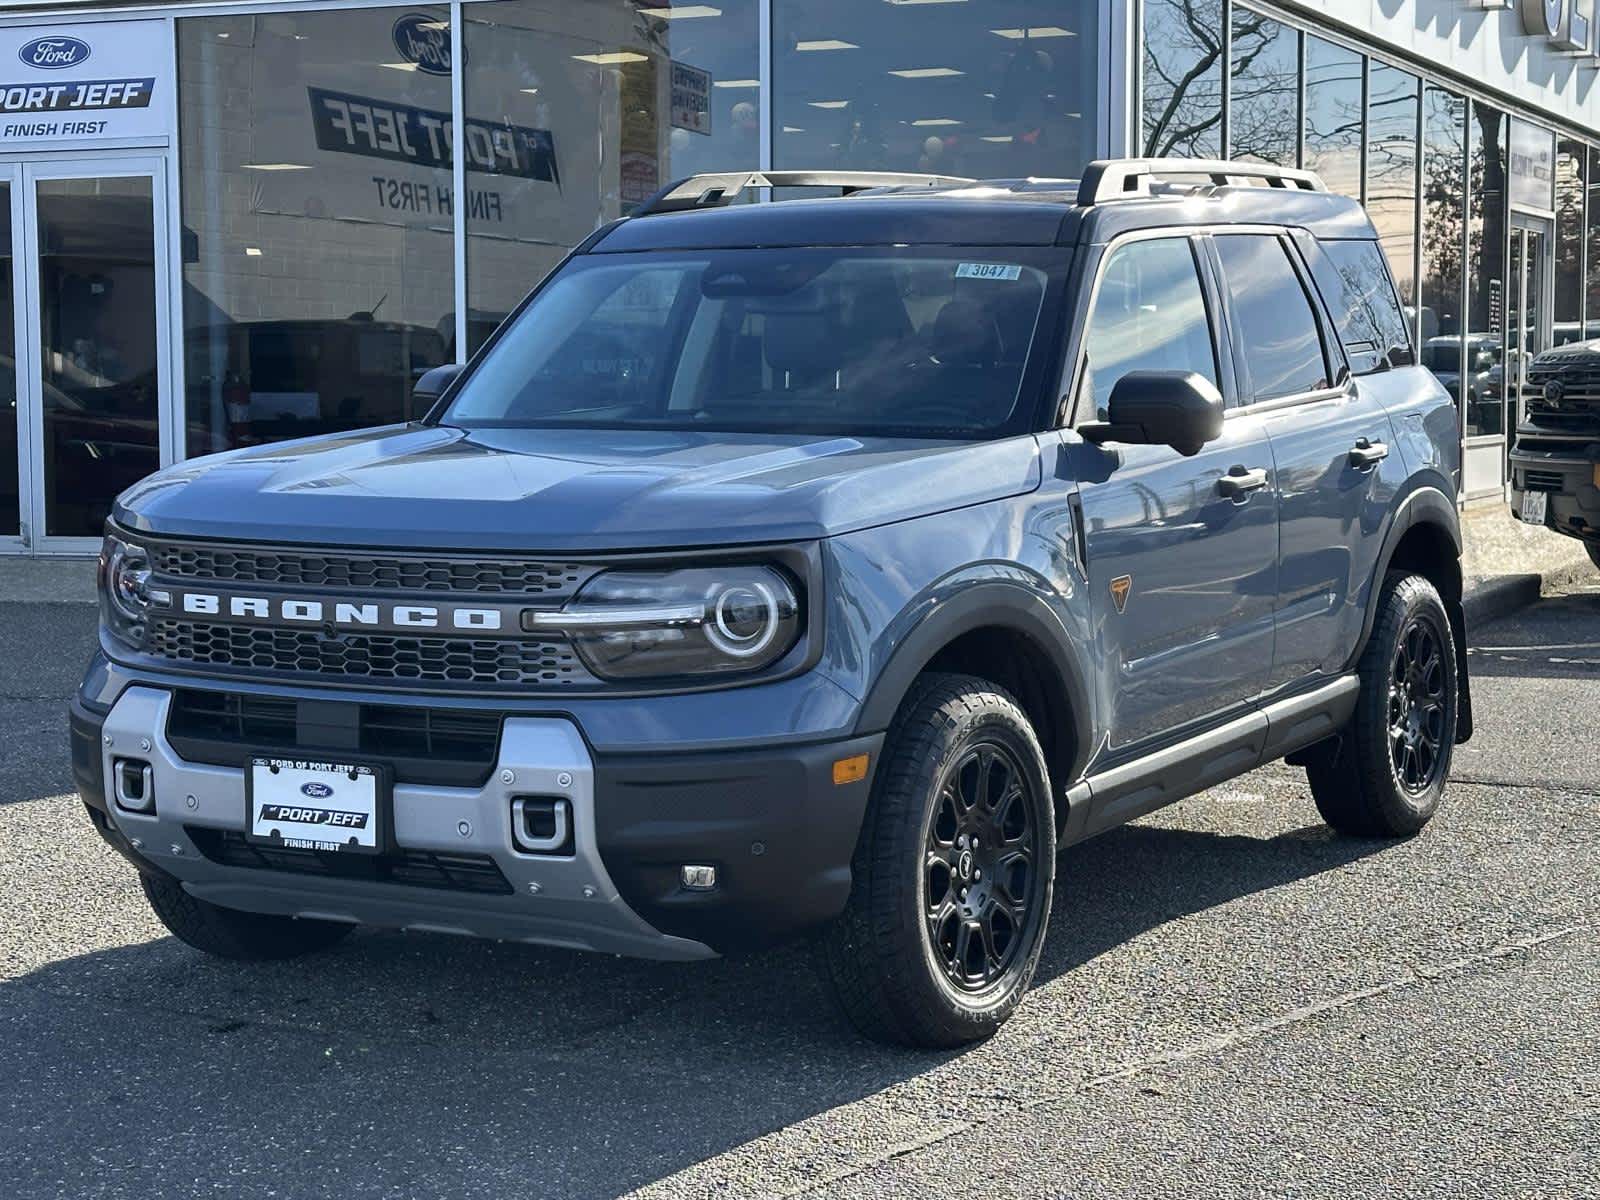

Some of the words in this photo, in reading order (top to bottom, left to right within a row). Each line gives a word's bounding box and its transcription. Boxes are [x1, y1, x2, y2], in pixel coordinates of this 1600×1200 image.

[33, 41, 76, 64] Ford
[70, 82, 143, 107] JEFF
[4, 123, 58, 137] FINISH
[62, 121, 107, 135] FIRST
[972, 264, 1006, 277] 3047
[183, 593, 501, 629] BRONCO
[270, 759, 294, 769] FORD
[296, 762, 307, 770] OF
[309, 763, 332, 773] PORT
[334, 764, 354, 774] JEFF
[306, 784, 328, 797] Ford
[278, 807, 323, 823] PORT
[325, 811, 363, 826] JEFF
[284, 838, 313, 850] FINISH
[315, 841, 341, 852] FIRST
